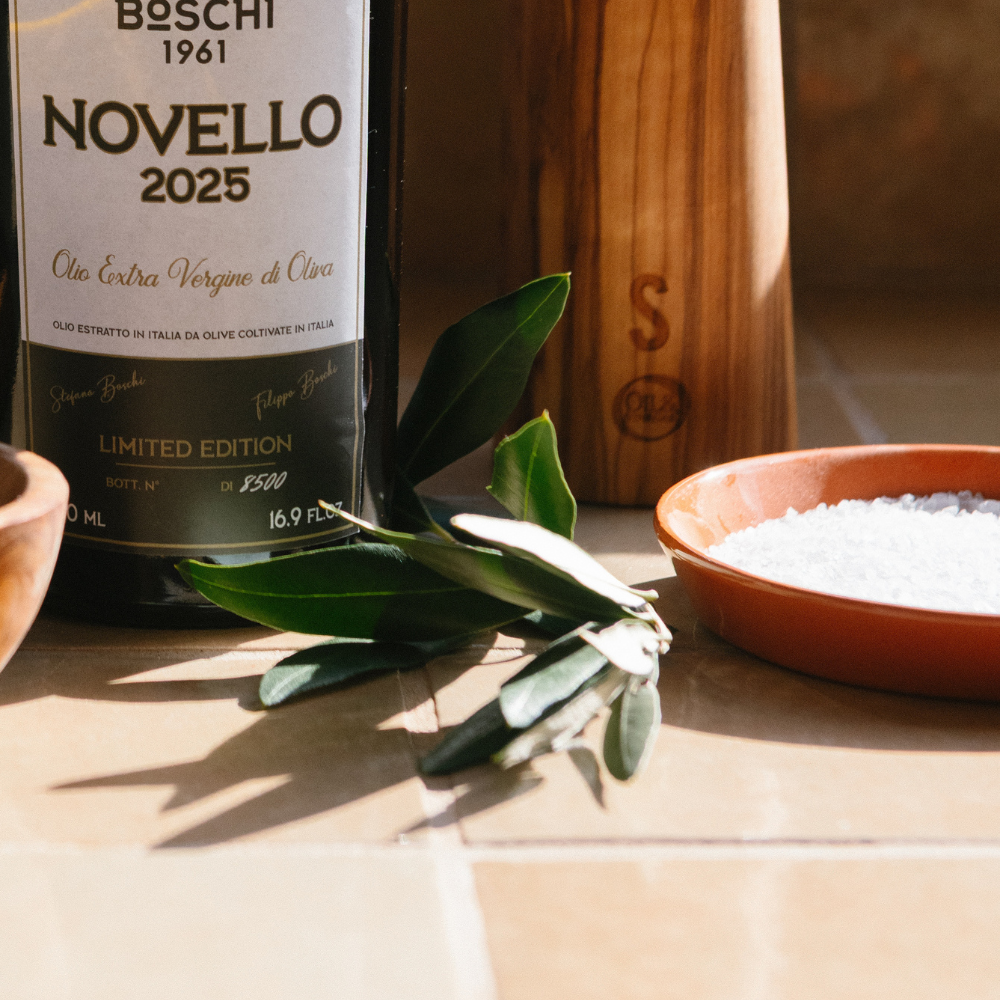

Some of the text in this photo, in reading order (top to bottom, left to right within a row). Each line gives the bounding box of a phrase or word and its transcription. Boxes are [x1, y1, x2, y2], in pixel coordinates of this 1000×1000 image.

[162, 39, 226, 65] 1961
[42, 93, 343, 157] NOVELLO
[139, 166, 251, 204] 2025
[51, 248, 334, 298] Olio Extra Vergine di Oliva
[629, 274, 671, 352] S
[52, 319, 335, 340] OLIO ESTRATTO IN ITALIA DA OLIVE COLTIVATE IN ITALIA
[99, 434, 292, 458] LIMITED EDITION
[105, 476, 142, 491] BOTT.
[220, 481, 234, 492] DI
[239, 471, 288, 493] 8500
[83, 509, 107, 527] ML
[269, 506, 302, 530] 16.9
